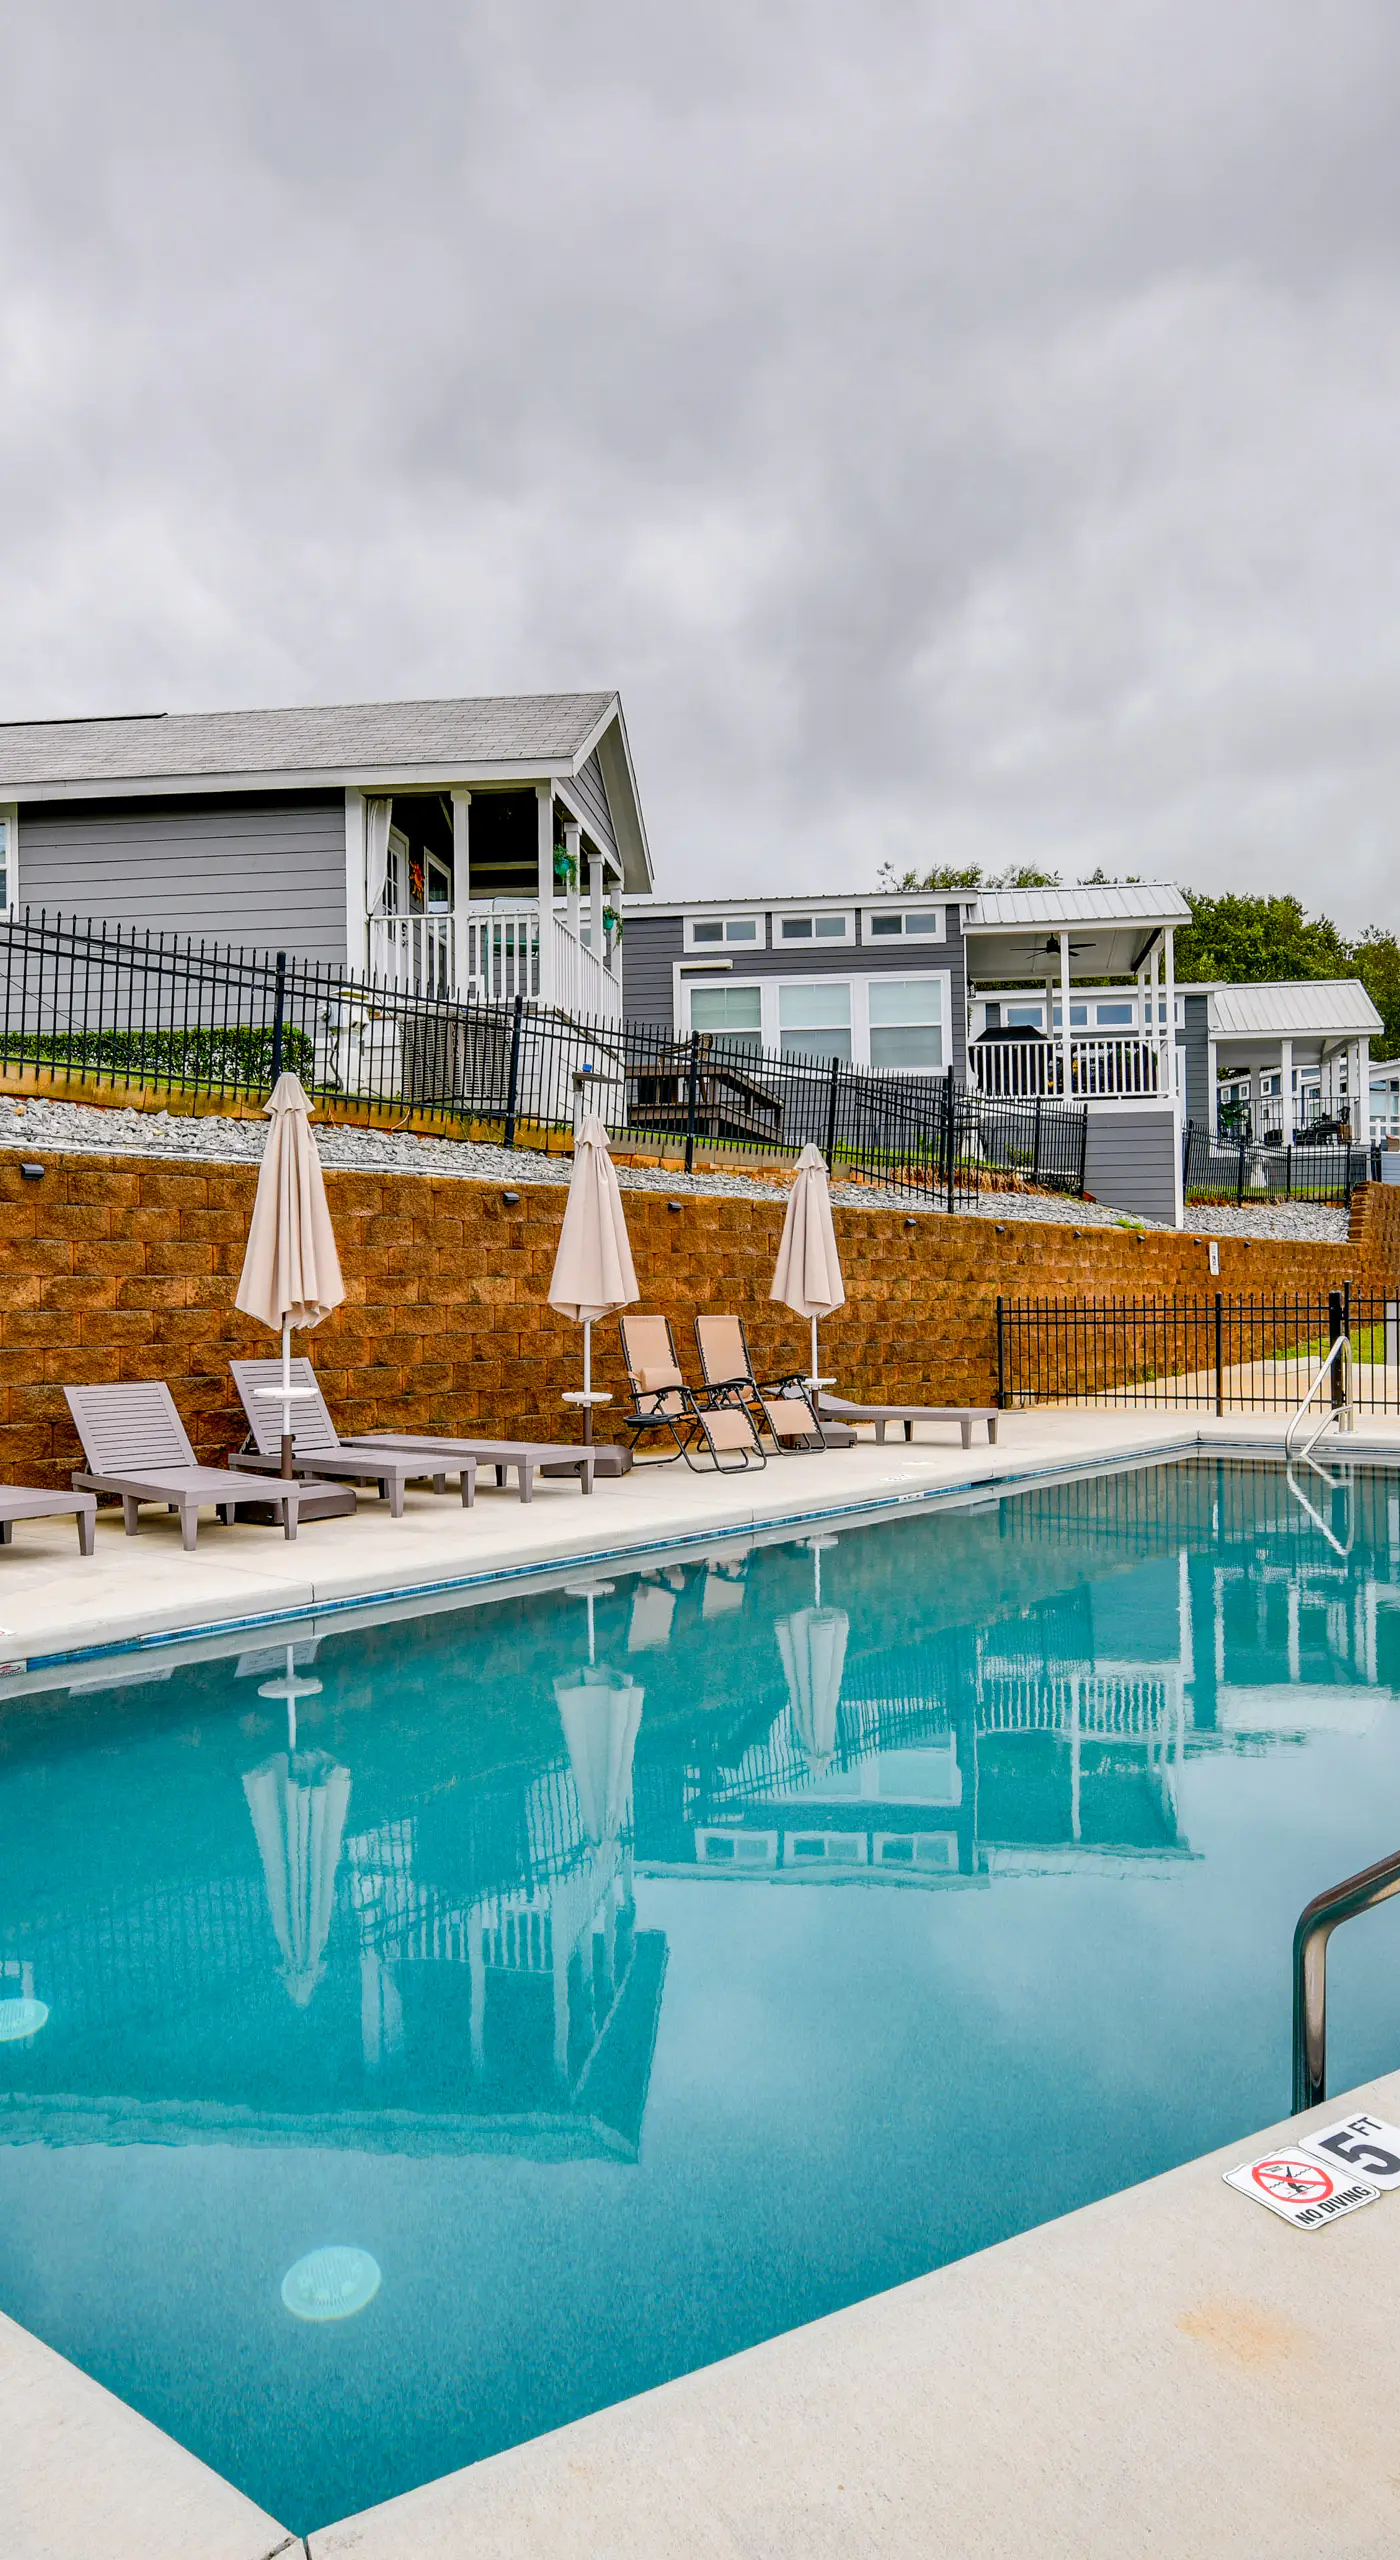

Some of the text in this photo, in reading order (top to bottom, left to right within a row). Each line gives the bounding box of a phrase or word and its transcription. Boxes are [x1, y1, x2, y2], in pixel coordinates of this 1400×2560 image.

[1318, 2117, 1400, 2175] 5 FT
[1295, 2186, 1372, 2225] NO DIVING
